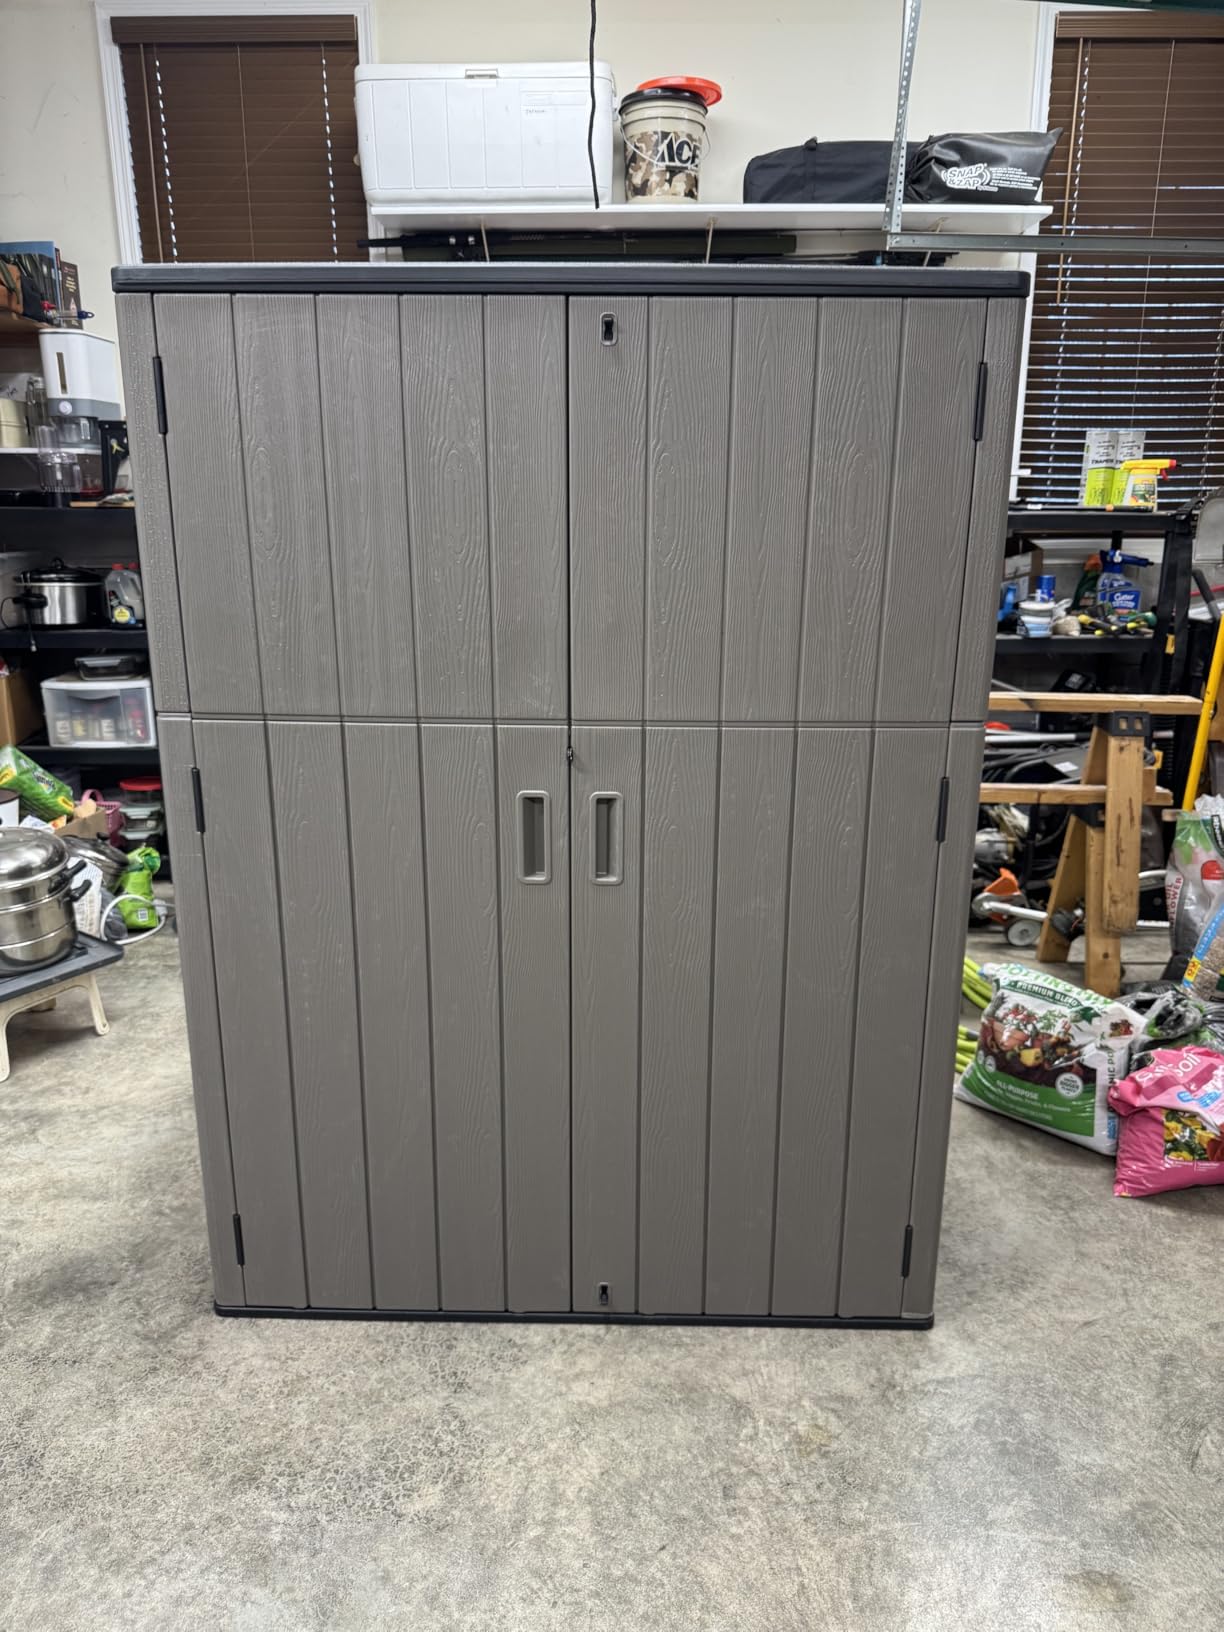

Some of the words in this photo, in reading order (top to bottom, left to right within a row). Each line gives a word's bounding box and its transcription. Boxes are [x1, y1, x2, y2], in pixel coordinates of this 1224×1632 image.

[655, 133, 701, 165] ACE
[947, 163, 984, 178] SNAP
[1016, 981, 1055, 997] PREMIUM
